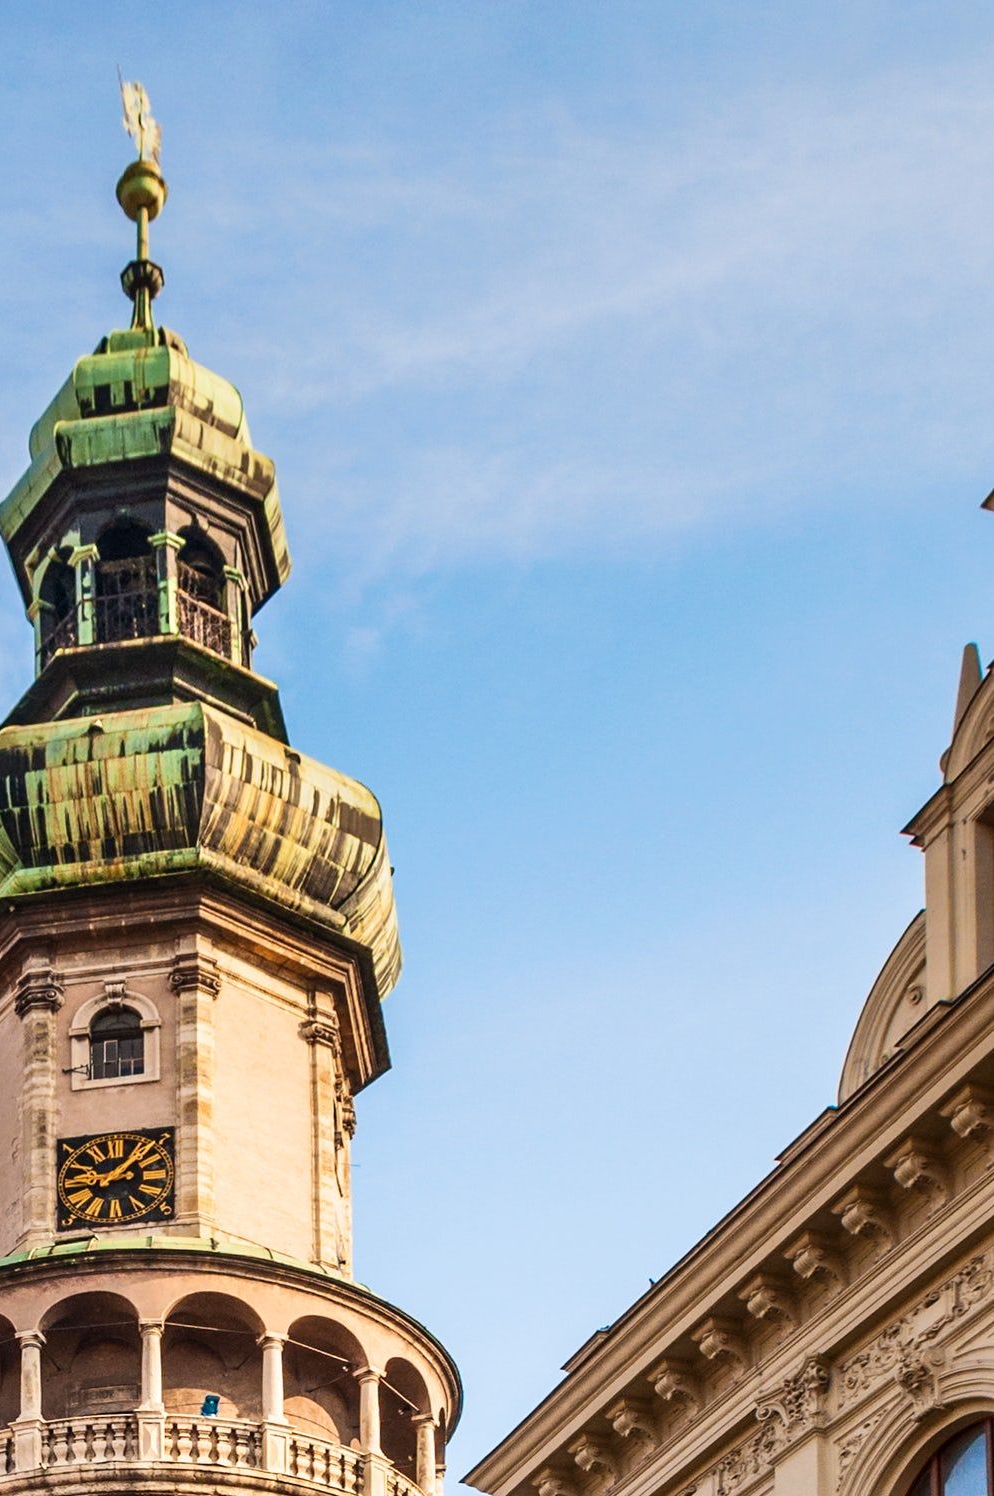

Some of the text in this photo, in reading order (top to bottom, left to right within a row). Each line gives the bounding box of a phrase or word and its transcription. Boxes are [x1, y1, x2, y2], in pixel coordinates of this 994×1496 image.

[86, 1145, 106, 1164] XI
[107, 1139, 124, 1159] XII
[138, 1153, 162, 1169] II
[143, 1169, 166, 1180] III
[67, 1188, 93, 1209] VIII
[84, 1197, 105, 1217] VII
[128, 1195, 145, 1211] V
[109, 1199, 123, 1218] VI
